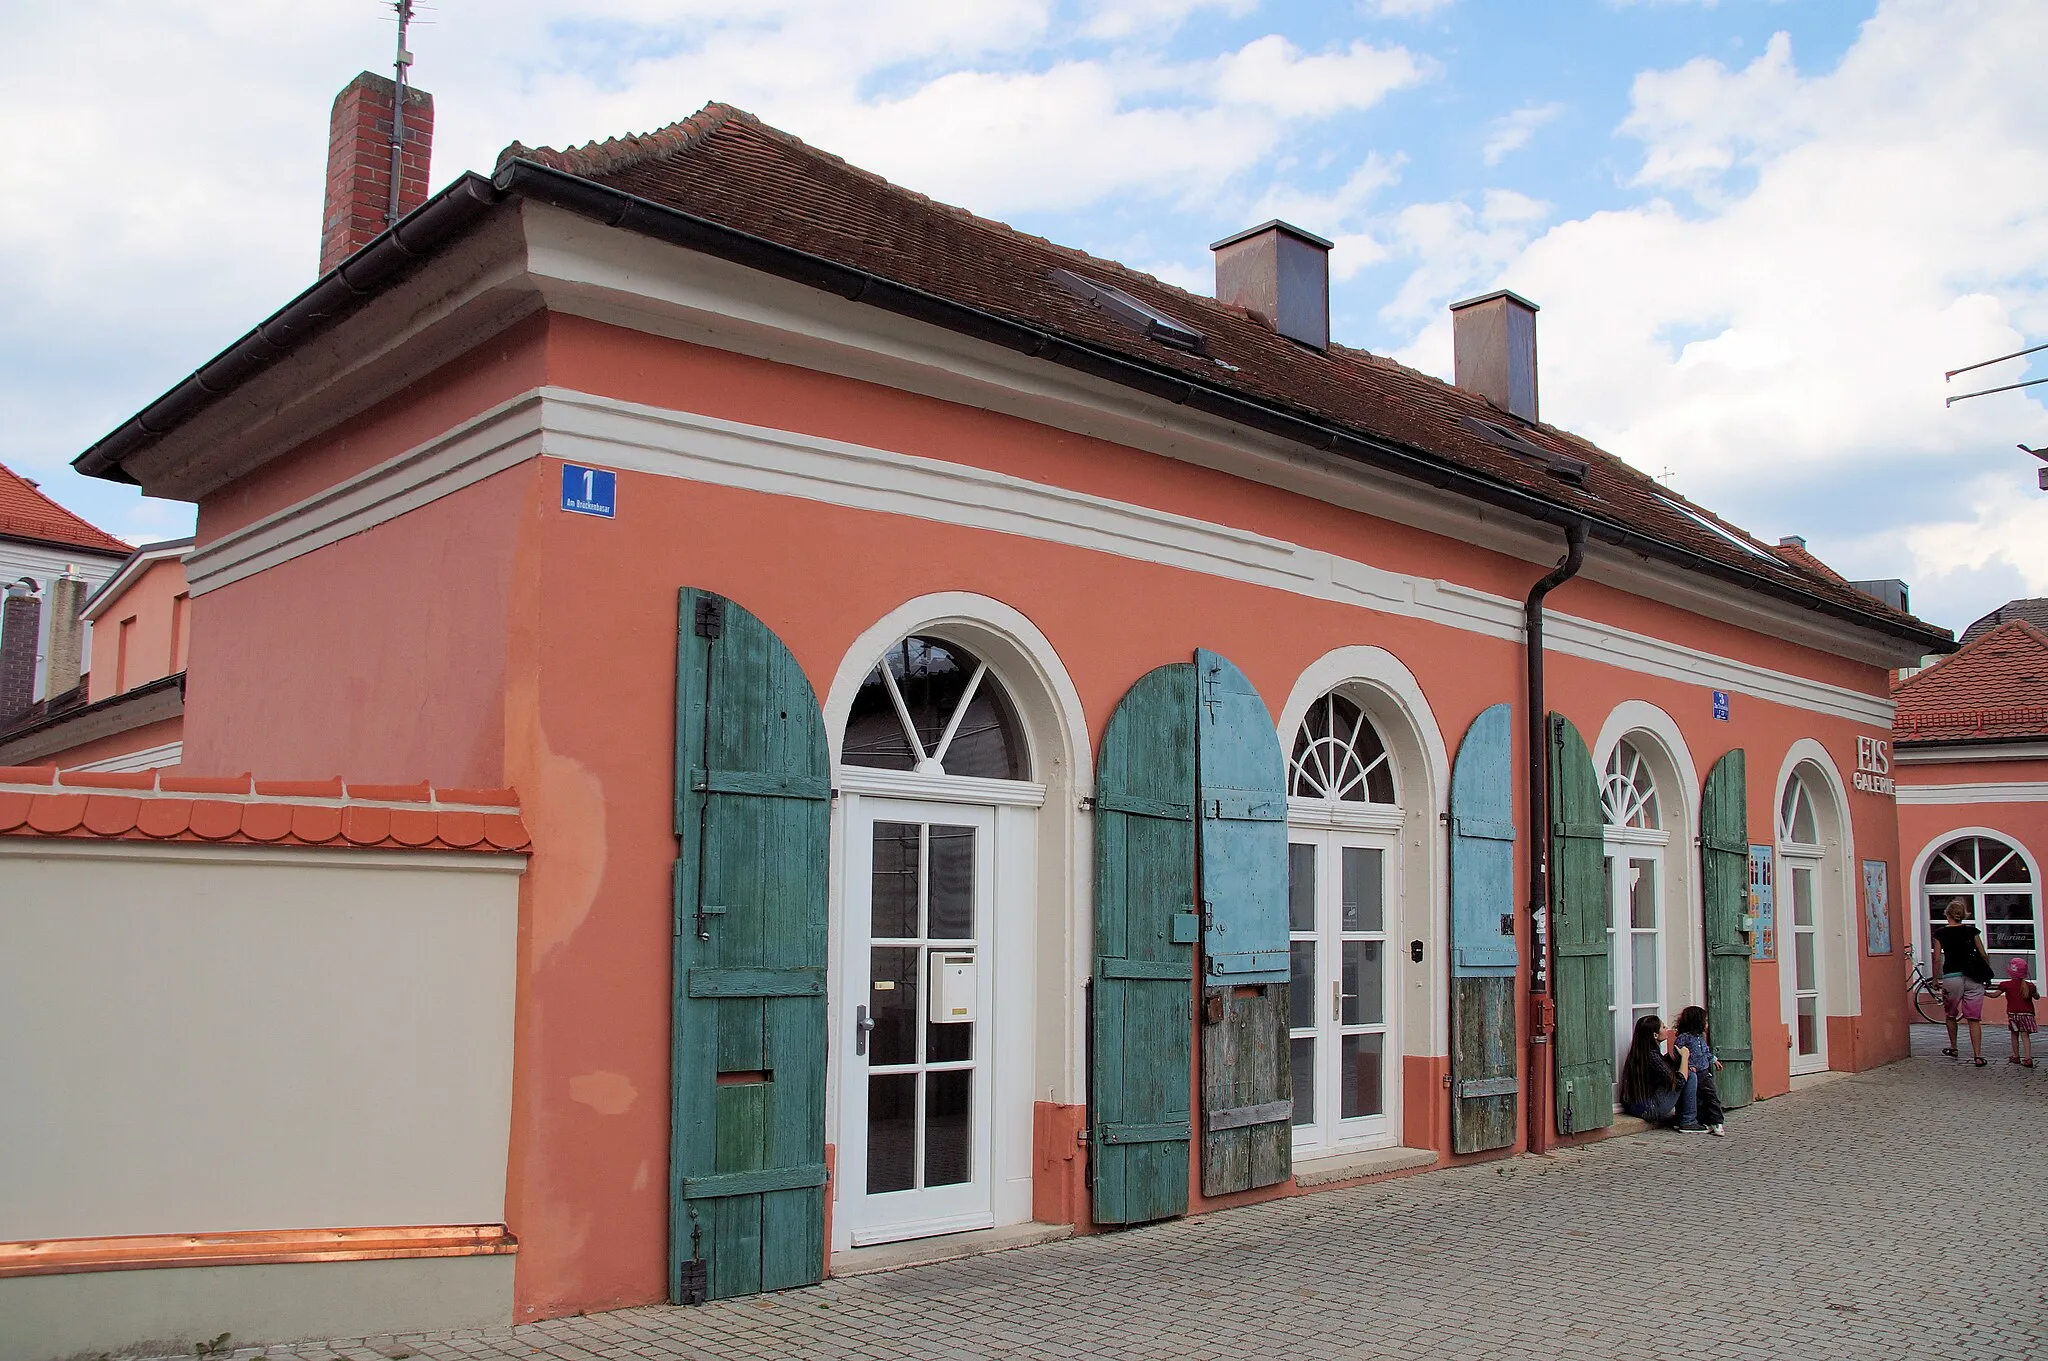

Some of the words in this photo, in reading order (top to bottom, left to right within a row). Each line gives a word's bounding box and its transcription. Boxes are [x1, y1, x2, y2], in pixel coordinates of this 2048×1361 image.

[583, 470, 594, 501] 1
[566, 498, 575, 507] Am
[1718, 692, 1725, 704] 3
[1856, 735, 1889, 775] EIS
[1852, 772, 1896, 795] GALERIE
